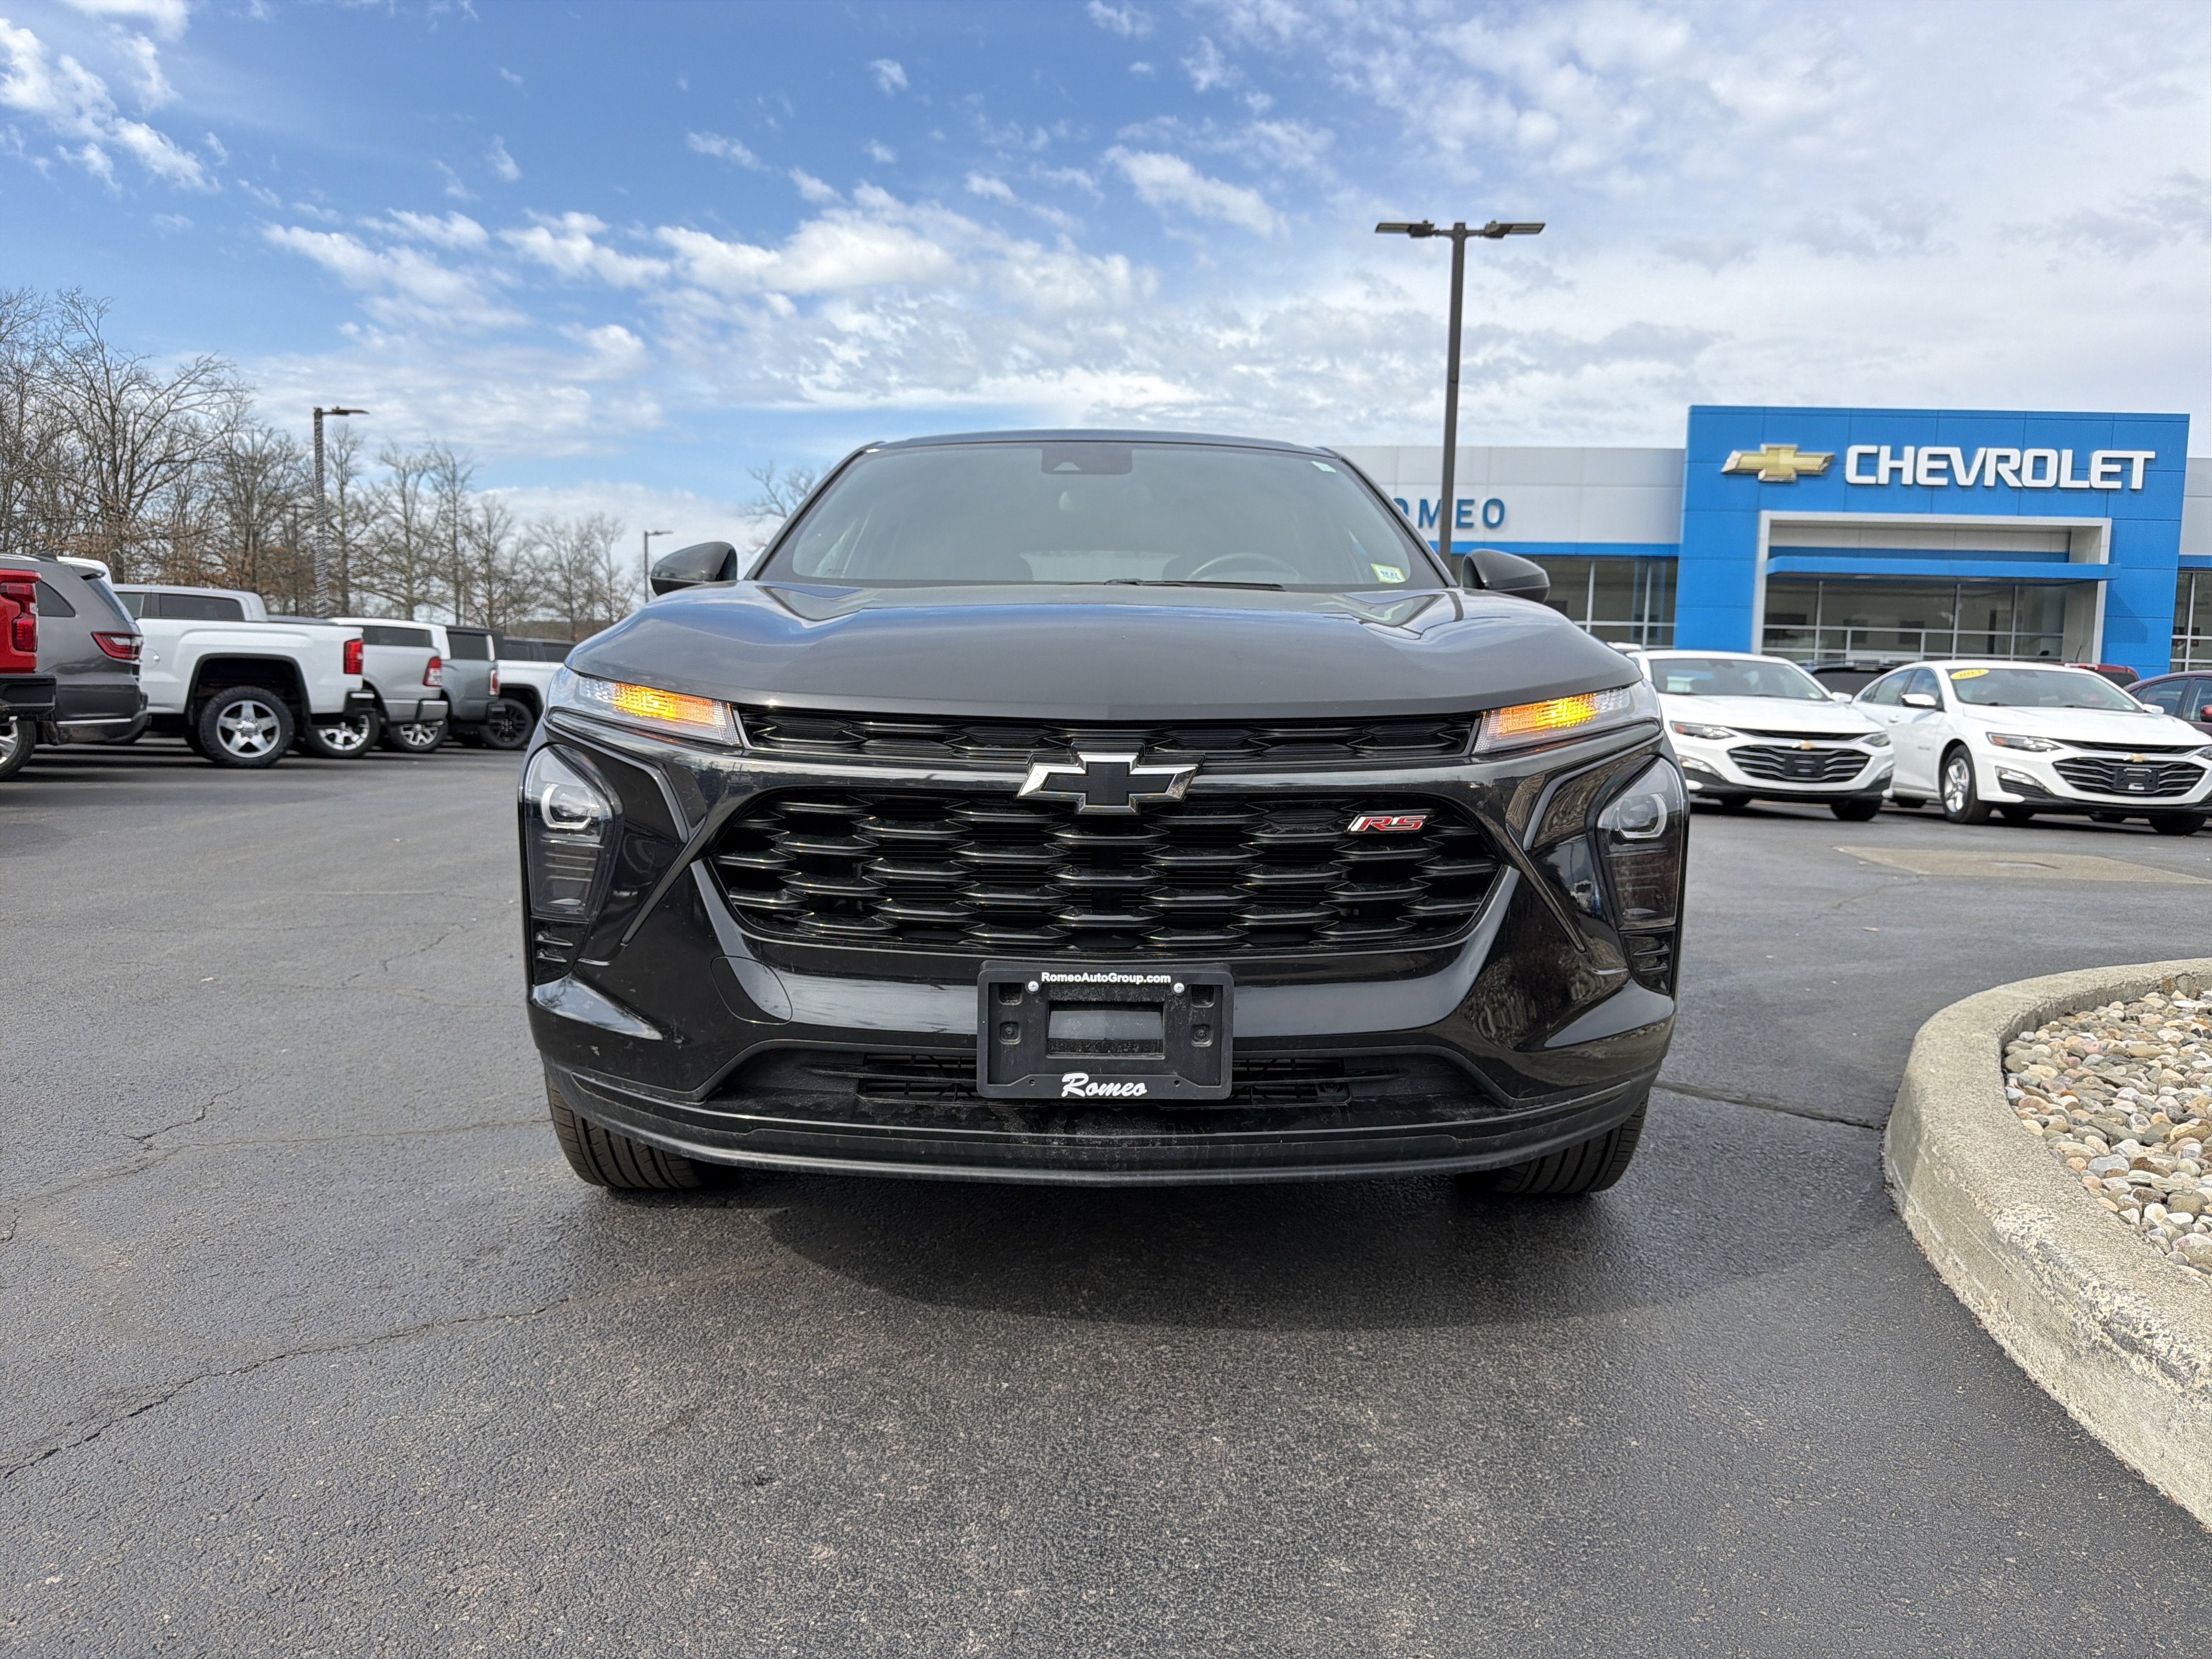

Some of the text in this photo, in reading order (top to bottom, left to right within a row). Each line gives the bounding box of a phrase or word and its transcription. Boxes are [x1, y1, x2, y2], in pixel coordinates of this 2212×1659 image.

[1846, 445, 2155, 489] CHEVROLET
[1351, 816, 1427, 832] RS
[1041, 972, 1171, 985] RomeoAutoGroup.com
[1061, 1073, 1148, 1097] Romeo
